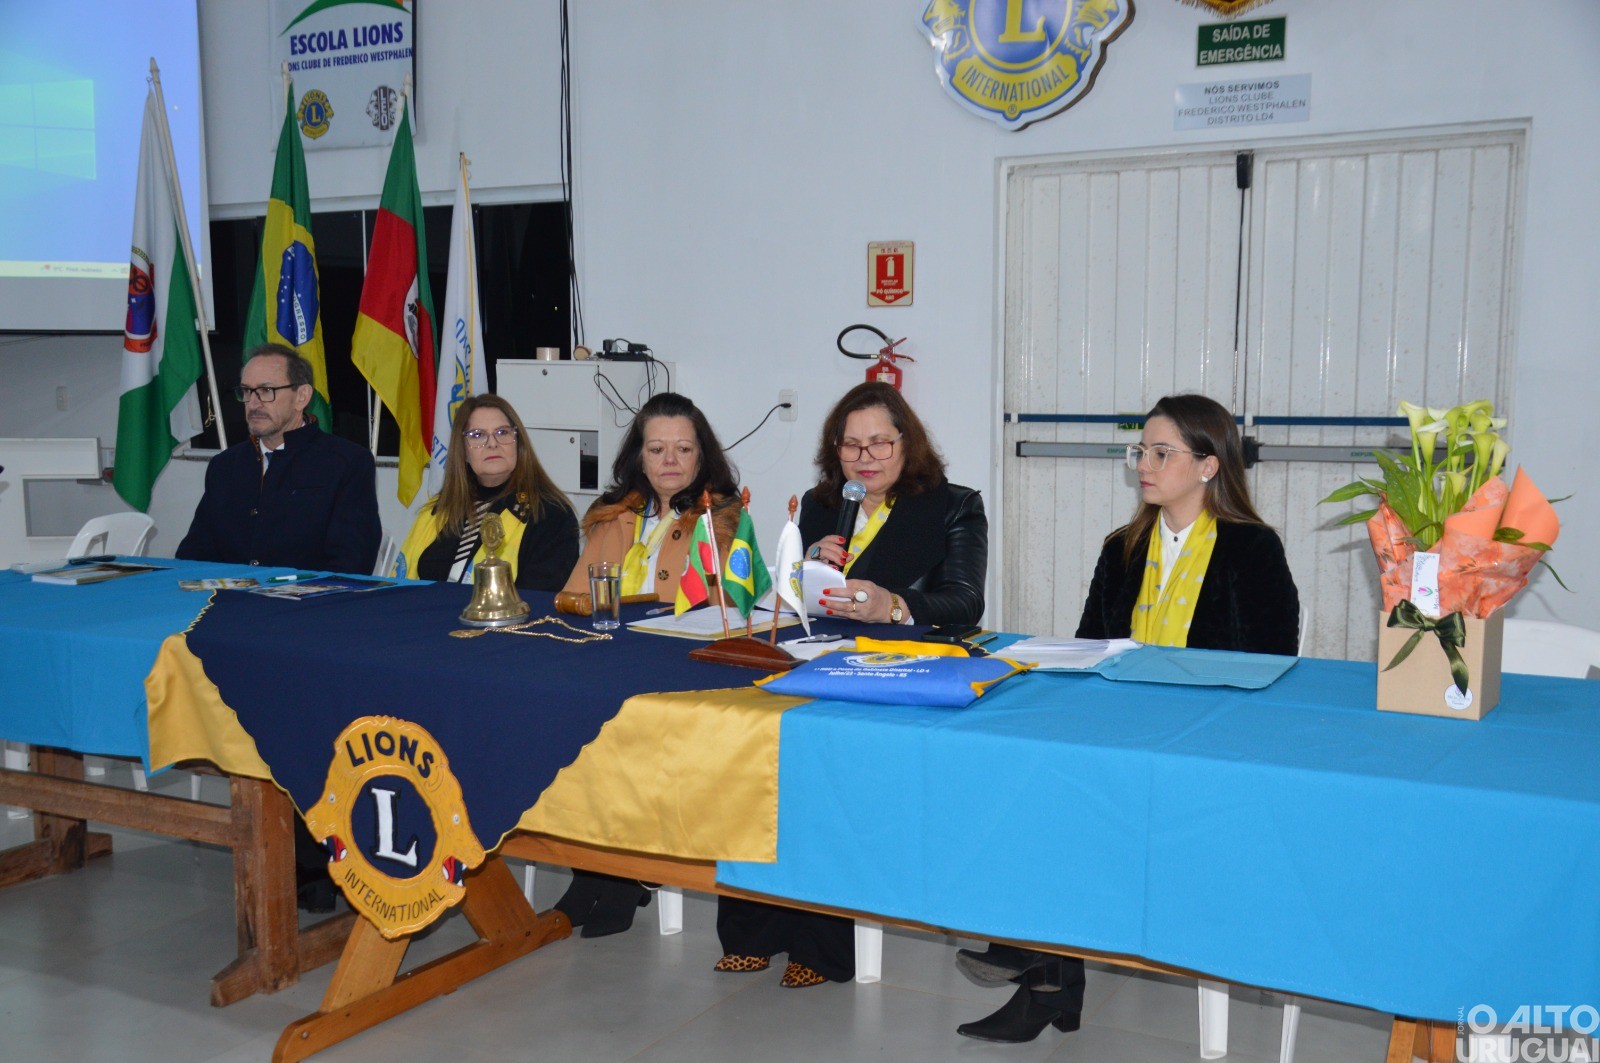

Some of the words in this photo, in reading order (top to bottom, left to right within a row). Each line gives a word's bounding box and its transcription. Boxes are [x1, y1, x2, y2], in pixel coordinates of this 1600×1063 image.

[998, 0, 1046, 42] L
[290, 29, 348, 55] ESCOLA
[353, 22, 403, 48] LIONS
[1212, 24, 1250, 43] SAÍDA
[1253, 24, 1271, 38] DE
[288, 62, 300, 72] ONS
[301, 59, 321, 71] CLUBE
[323, 57, 331, 68] DE
[333, 53, 369, 67] FREDERICO
[370, 48, 412, 63] WESTPHALEN
[1200, 43, 1283, 64] EMERGÊNCIA
[962, 65, 1069, 102] INTERNATIONAL
[1204, 82, 1226, 95] NÓS
[1228, 80, 1280, 93] SERVIMOS
[380, 88, 388, 126] LEO
[1178, 105, 1235, 117] FREDERICO
[1237, 99, 1307, 112] WESTPHALEN
[1209, 94, 1239, 105] LIONS
[1241, 92, 1274, 101] CLUBE
[311, 105, 321, 122] L
[1207, 115, 1253, 126] DISTRITO
[1255, 112, 1274, 121] LD4
[346, 730, 434, 779] LIONS
[370, 787, 418, 868] L
[344, 868, 446, 923] INTERNATIONAL
